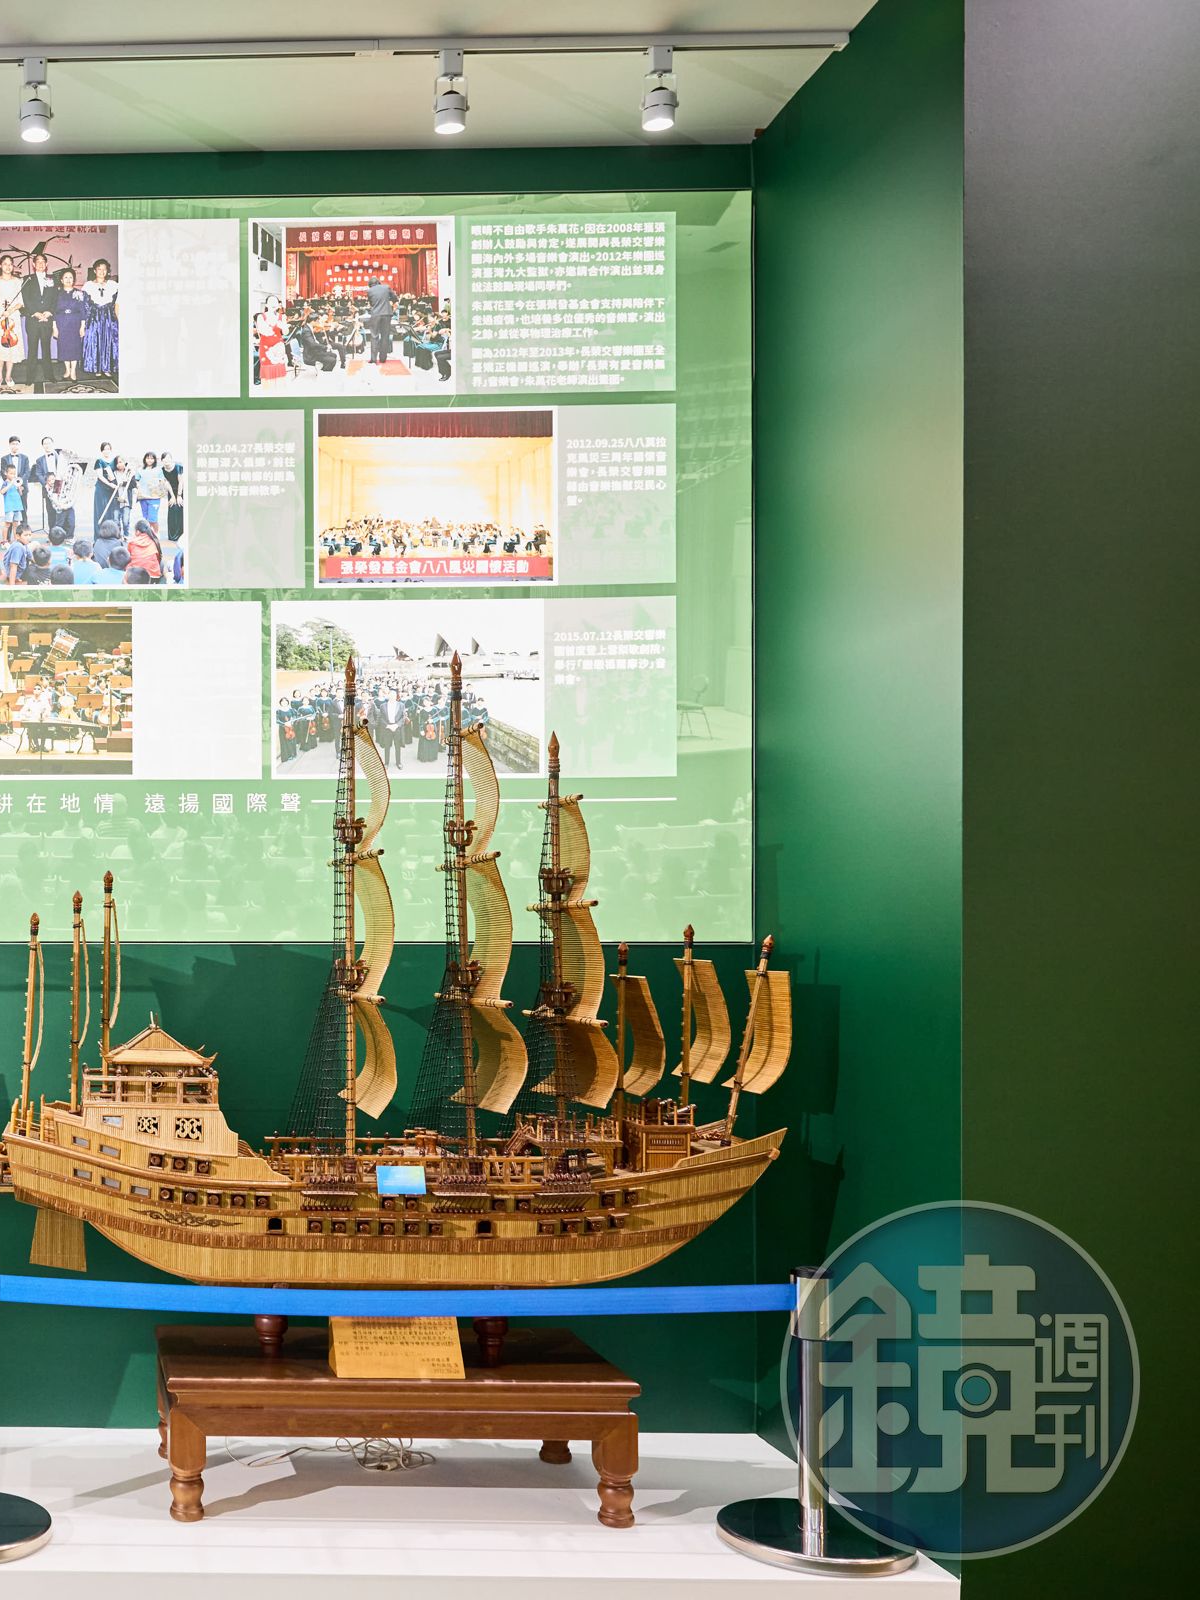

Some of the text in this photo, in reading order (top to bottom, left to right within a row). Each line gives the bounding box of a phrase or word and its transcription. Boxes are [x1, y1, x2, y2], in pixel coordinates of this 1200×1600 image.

[144, 792, 302, 815] 遠揚國際聲
